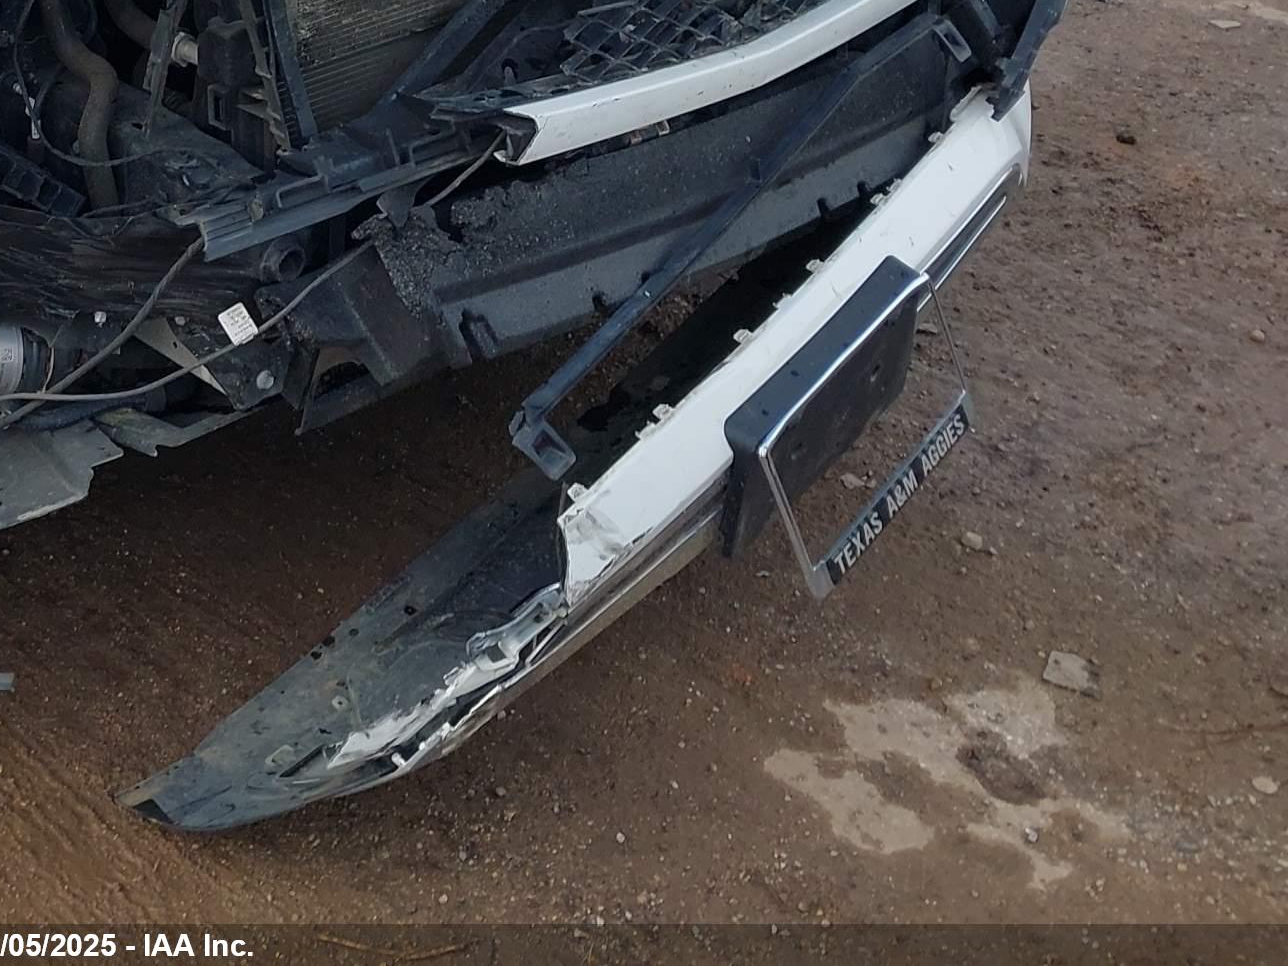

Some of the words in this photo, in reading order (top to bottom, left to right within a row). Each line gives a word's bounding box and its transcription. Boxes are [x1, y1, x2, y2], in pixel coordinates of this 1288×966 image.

[833, 512, 883, 574] TEXAS
[885, 469, 919, 518] A&M
[920, 414, 964, 476] AGGIES
